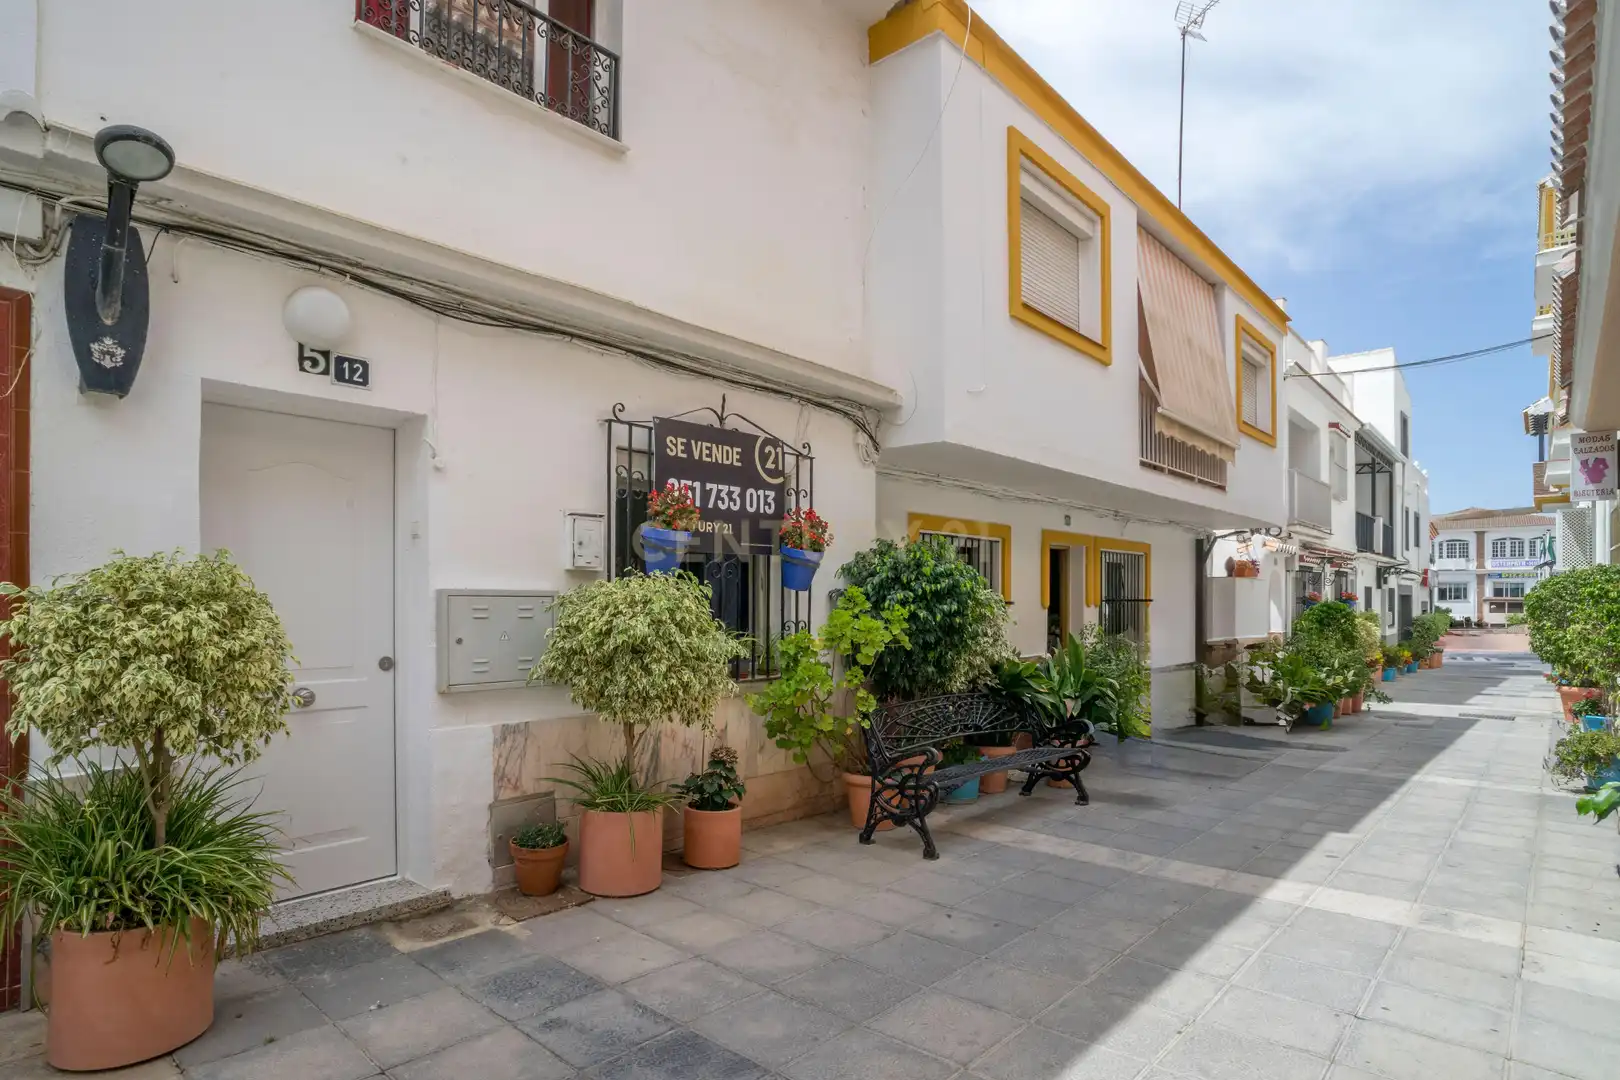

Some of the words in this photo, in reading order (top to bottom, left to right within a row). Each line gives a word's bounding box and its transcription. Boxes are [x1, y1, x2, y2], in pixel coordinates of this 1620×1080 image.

[303, 344, 326, 374] 5
[343, 361, 363, 382] 12
[1573, 444, 1615, 454] CALZADOS
[1577, 434, 1611, 444] MODAS
[666, 435, 688, 458] SE
[691, 439, 742, 467] VENDE
[705, 482, 741, 511] 733
[745, 487, 776, 515] 013
[722, 523, 733, 535] 21
